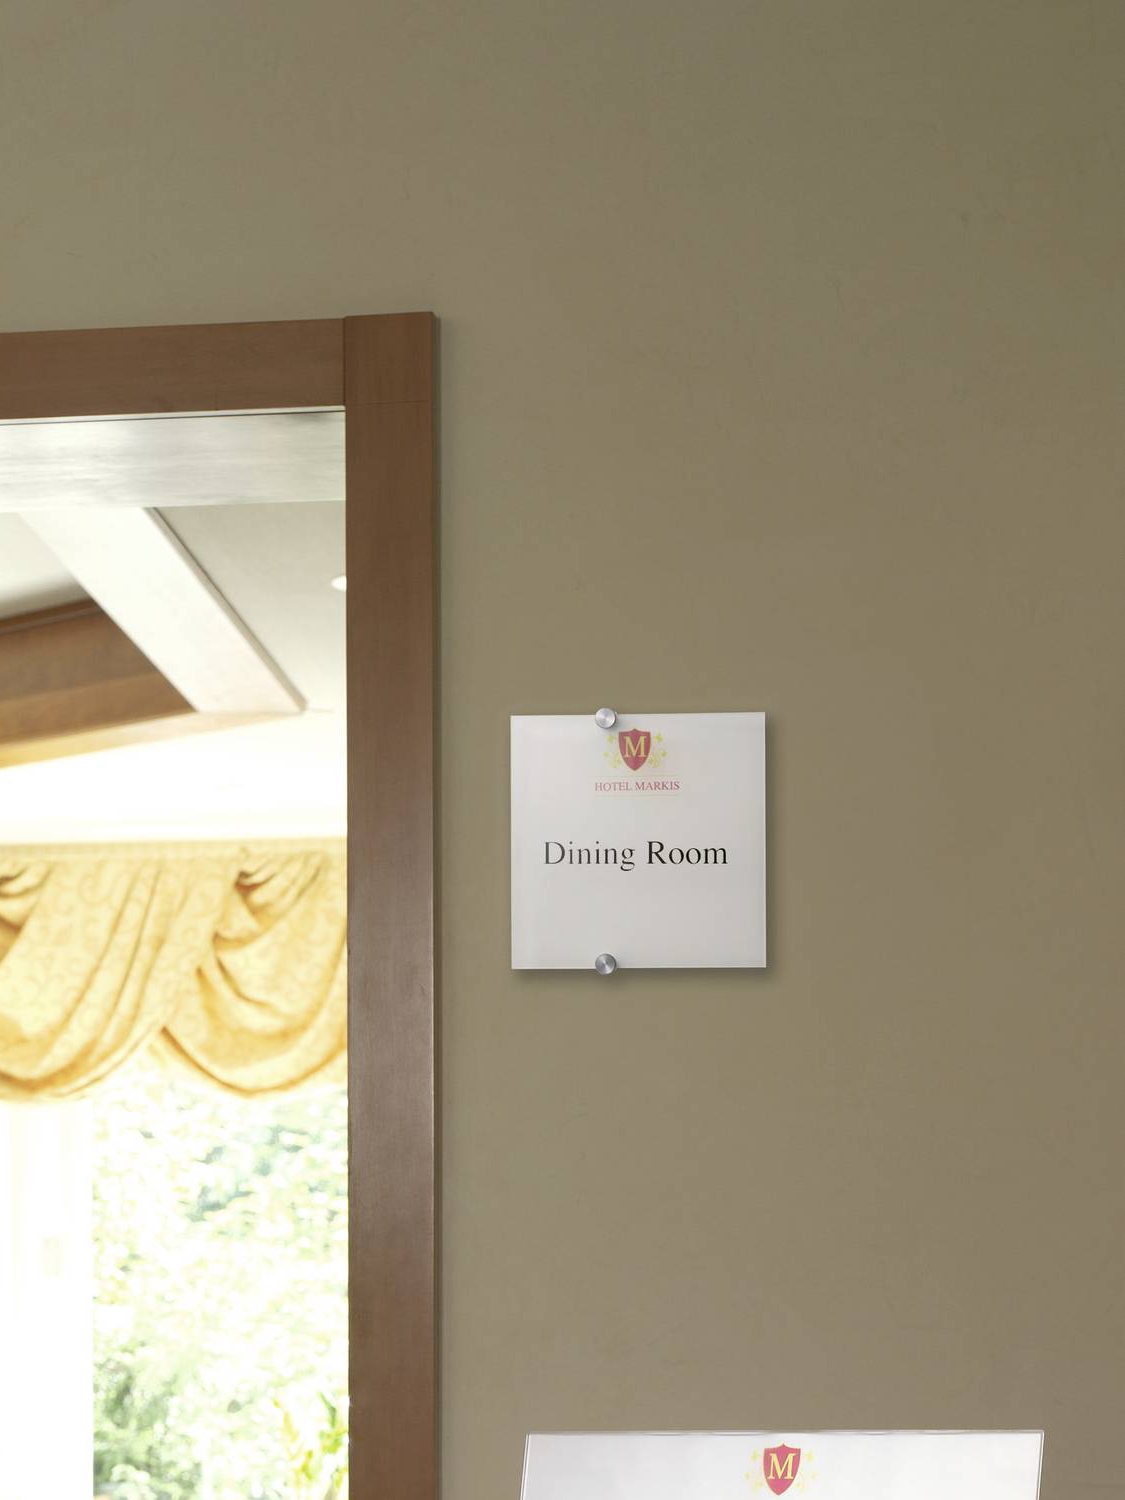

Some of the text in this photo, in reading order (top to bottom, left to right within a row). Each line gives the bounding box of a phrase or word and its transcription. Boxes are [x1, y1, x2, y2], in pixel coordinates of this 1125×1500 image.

[623, 735, 648, 758] M
[595, 780, 680, 792] HOTEL MARKIS
[544, 840, 728, 872] Dining Room
[767, 1453, 796, 1480] M
